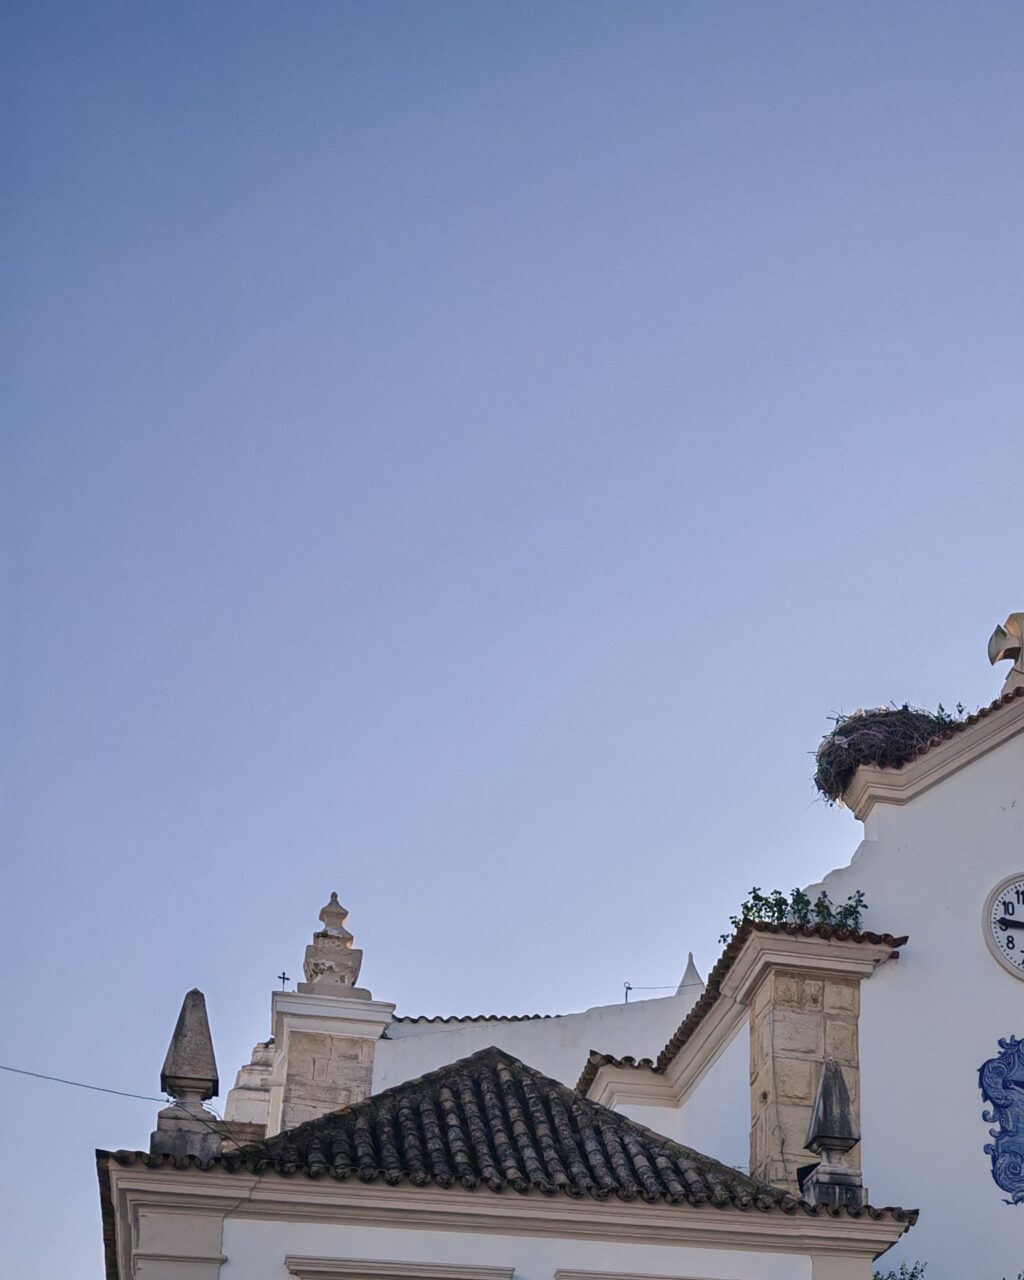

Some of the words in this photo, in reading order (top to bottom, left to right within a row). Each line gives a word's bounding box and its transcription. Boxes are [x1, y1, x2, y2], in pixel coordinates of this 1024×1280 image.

[1015, 889, 1024, 905] 11
[1002, 900, 1015, 916] 10
[1006, 935, 1015, 950] 8
